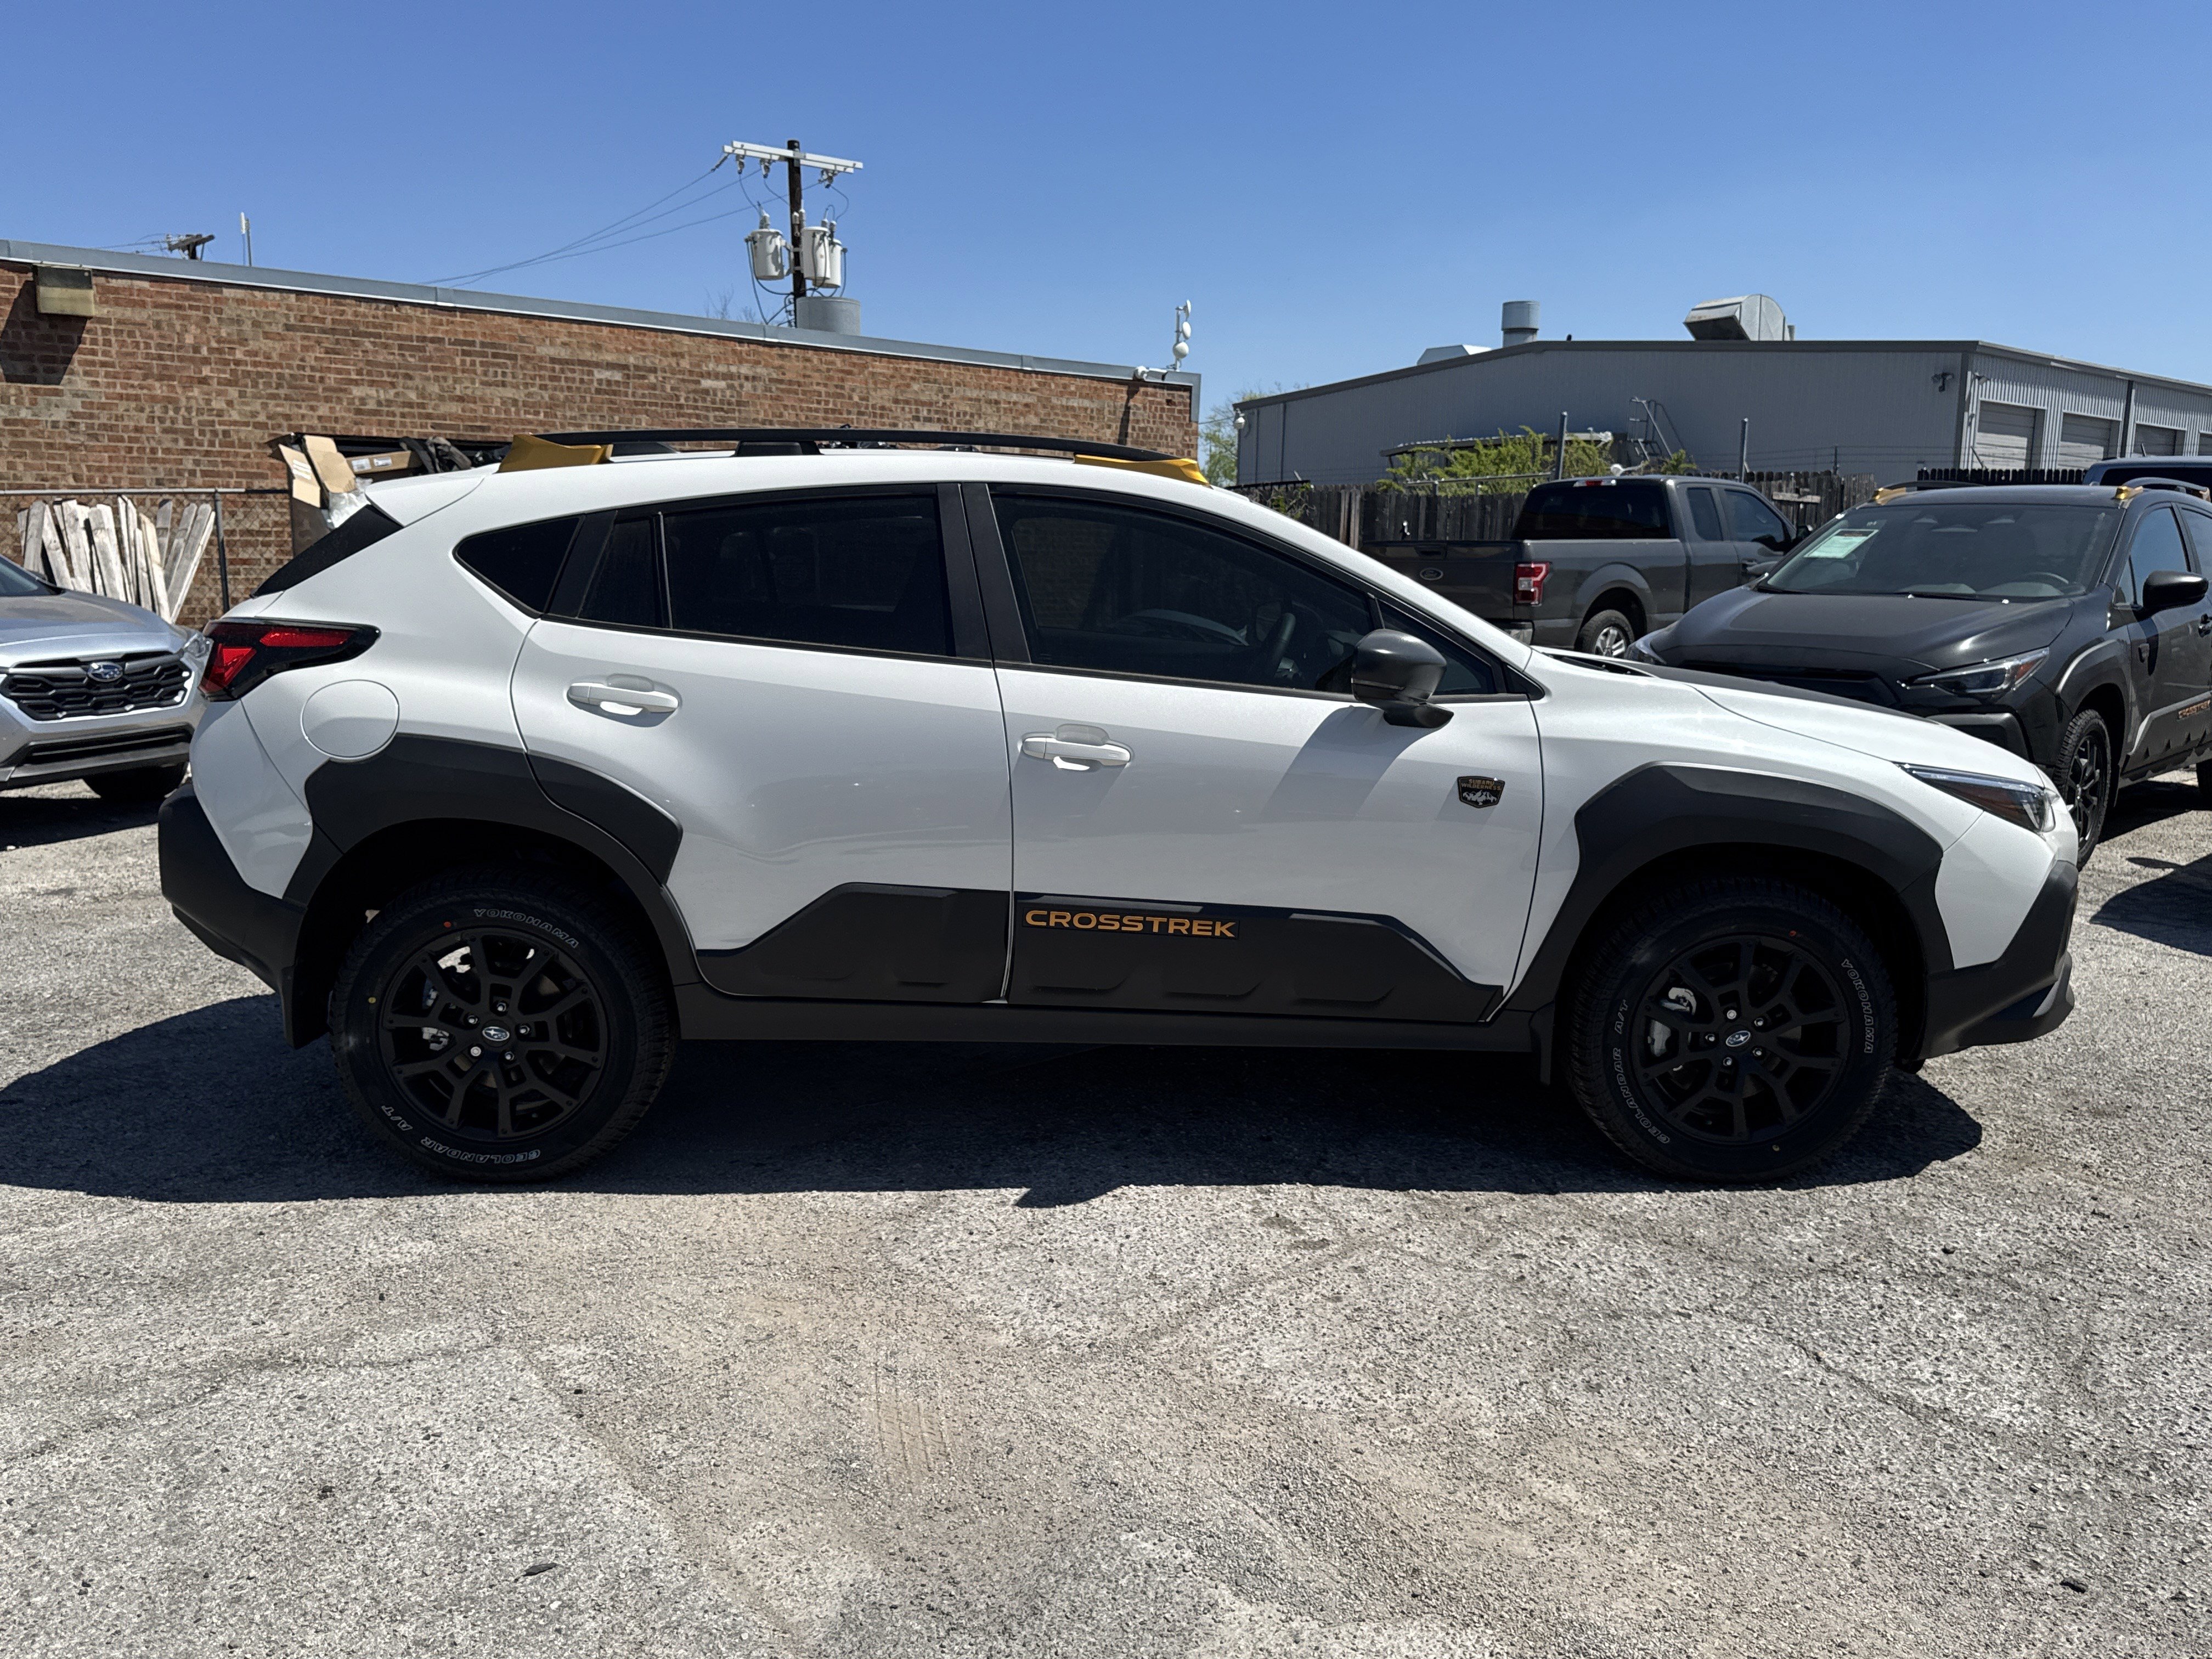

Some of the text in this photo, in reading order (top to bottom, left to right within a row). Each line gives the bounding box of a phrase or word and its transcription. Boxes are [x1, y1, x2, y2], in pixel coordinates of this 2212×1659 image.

[474, 909, 579, 949] YOKOHAMA
[1025, 910, 1235, 938] CROSSTREK
[1841, 958, 1875, 1054] YOKOHAMA
[1613, 1000, 1671, 1144] GEOLANDAR A/T
[381, 1105, 541, 1165] GEOLANDAR A/T
